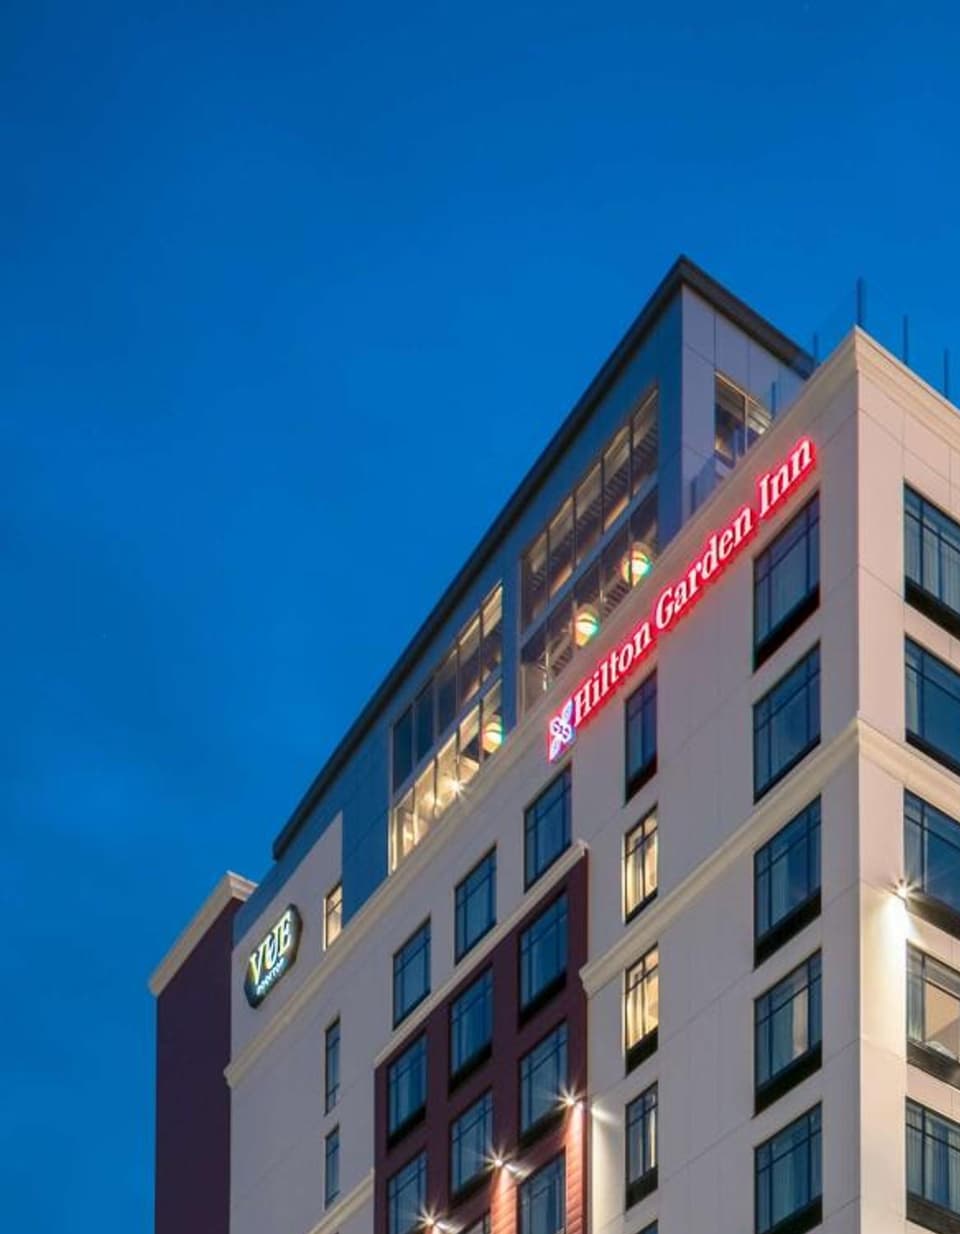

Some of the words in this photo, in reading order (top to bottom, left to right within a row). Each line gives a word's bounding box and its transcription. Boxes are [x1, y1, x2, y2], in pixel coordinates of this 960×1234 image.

[574, 623, 652, 727] Hilton
[655, 507, 753, 630] Garden
[759, 438, 813, 518] Inn
[249, 910, 292, 986] VUE
